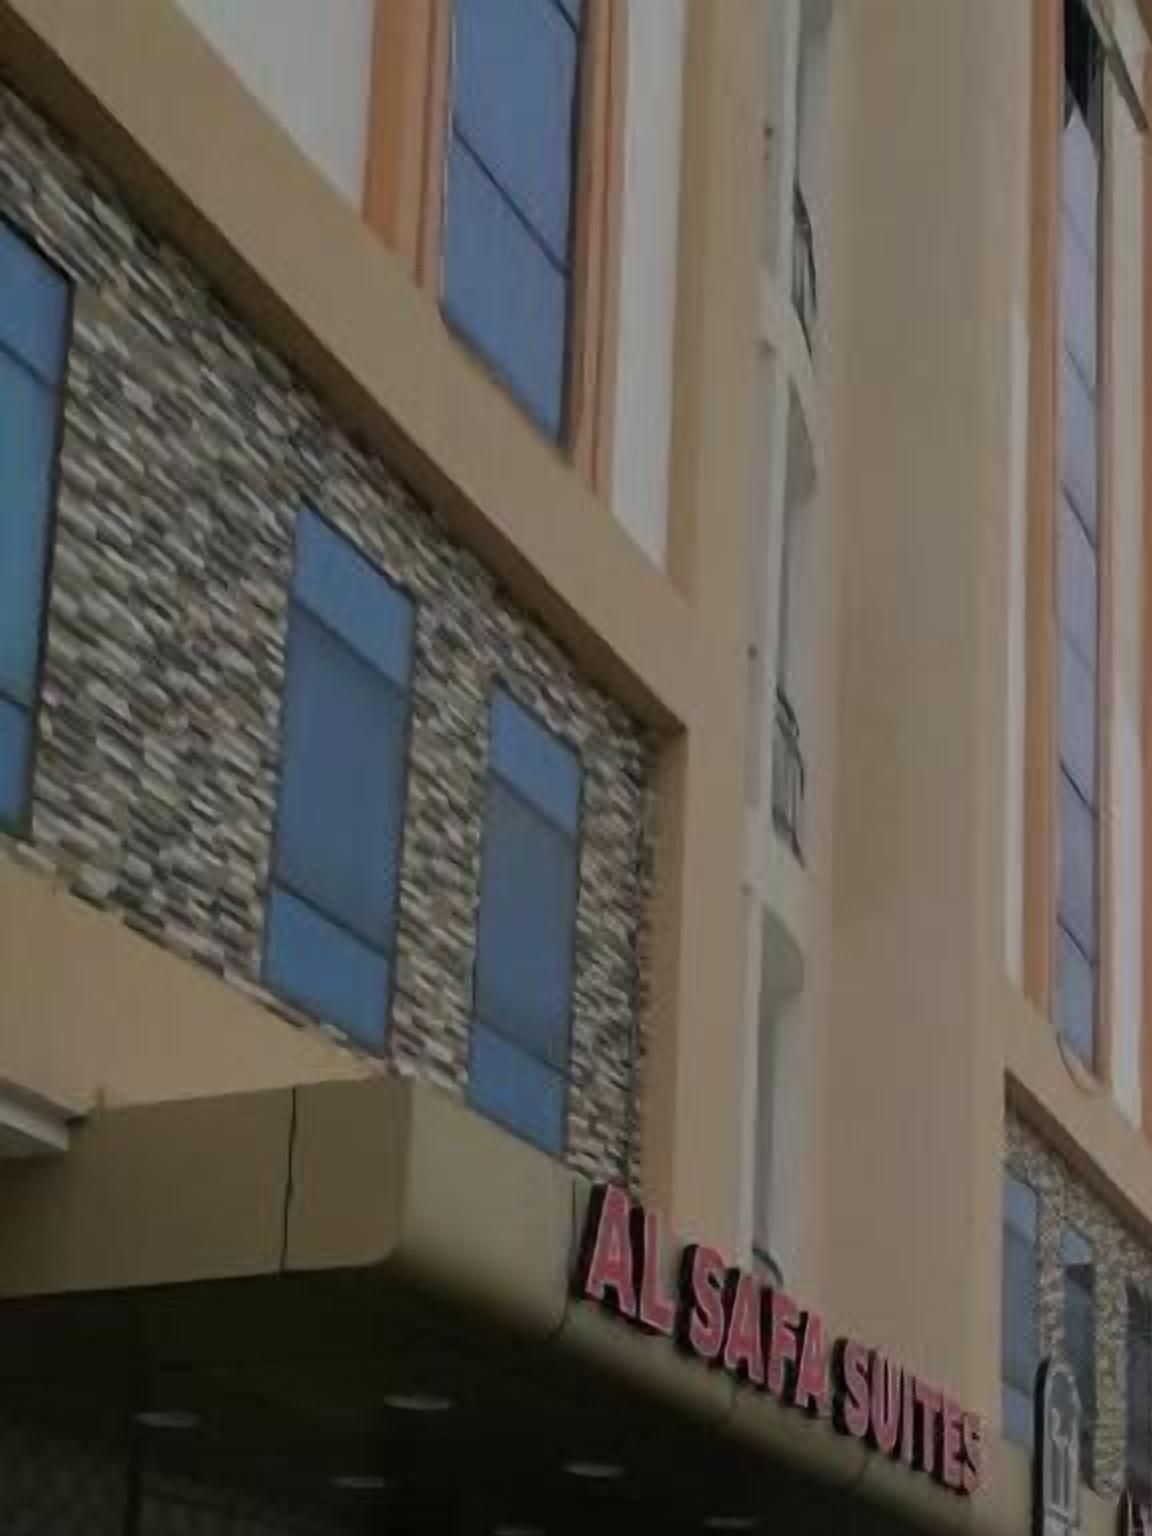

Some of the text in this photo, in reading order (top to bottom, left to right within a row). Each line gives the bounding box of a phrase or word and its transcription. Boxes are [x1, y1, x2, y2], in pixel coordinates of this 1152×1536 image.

[584, 1181, 983, 1497] AL SAFA SUITES
